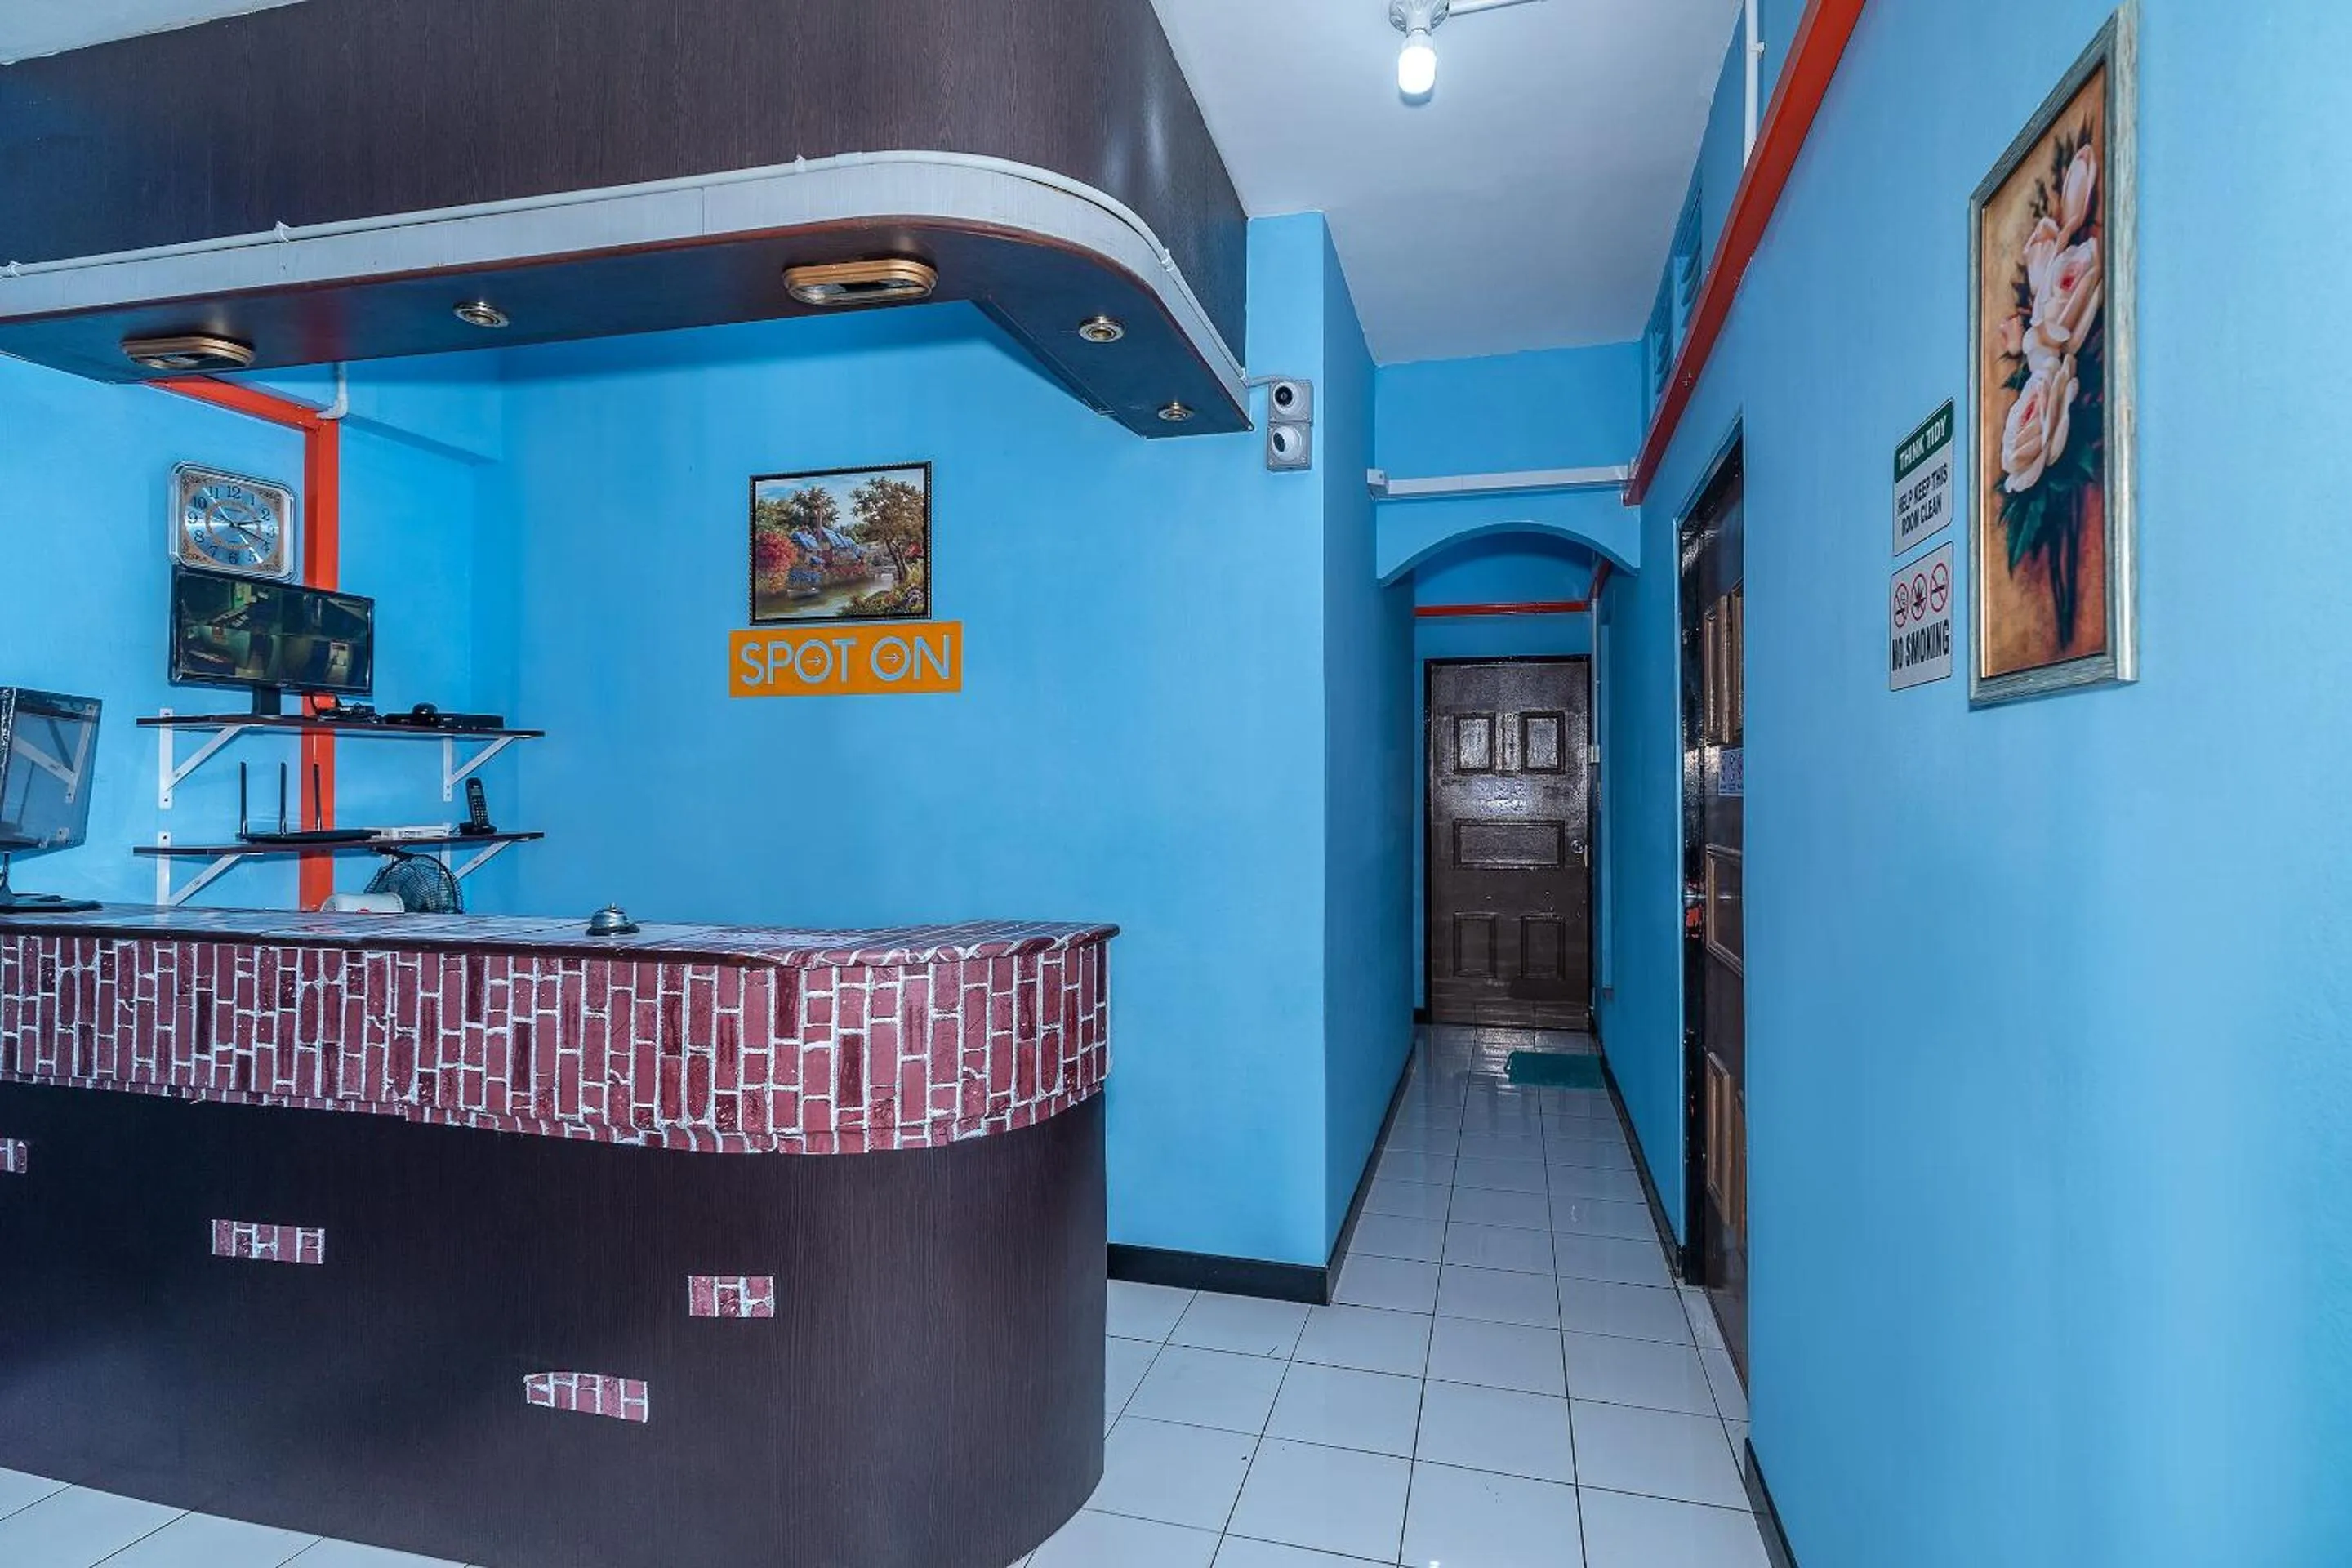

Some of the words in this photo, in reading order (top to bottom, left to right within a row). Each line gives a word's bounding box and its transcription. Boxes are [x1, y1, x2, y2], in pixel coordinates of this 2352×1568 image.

[1899, 434, 1925, 471] THINK
[1925, 415, 1948, 448] TIDY
[209, 486, 219, 499] 11
[227, 485, 241, 499] 12
[1897, 488, 1913, 515] HELP
[1913, 476, 1931, 504] KEEP
[1931, 463, 1949, 490] THIS
[193, 496, 207, 509] 10
[188, 511, 198, 524] 9
[261, 508, 270, 521] 2
[1901, 507, 1920, 537] ROOM
[1920, 492, 1942, 524] CLEAN
[194, 530, 204, 543] 8
[209, 546, 218, 558] 7
[229, 551, 238, 564] 6
[1891, 632, 1904, 672] NO
[1905, 619, 1950, 666] SMOKING
[740, 638, 858, 687] SPOT
[870, 634, 951, 682] ON
